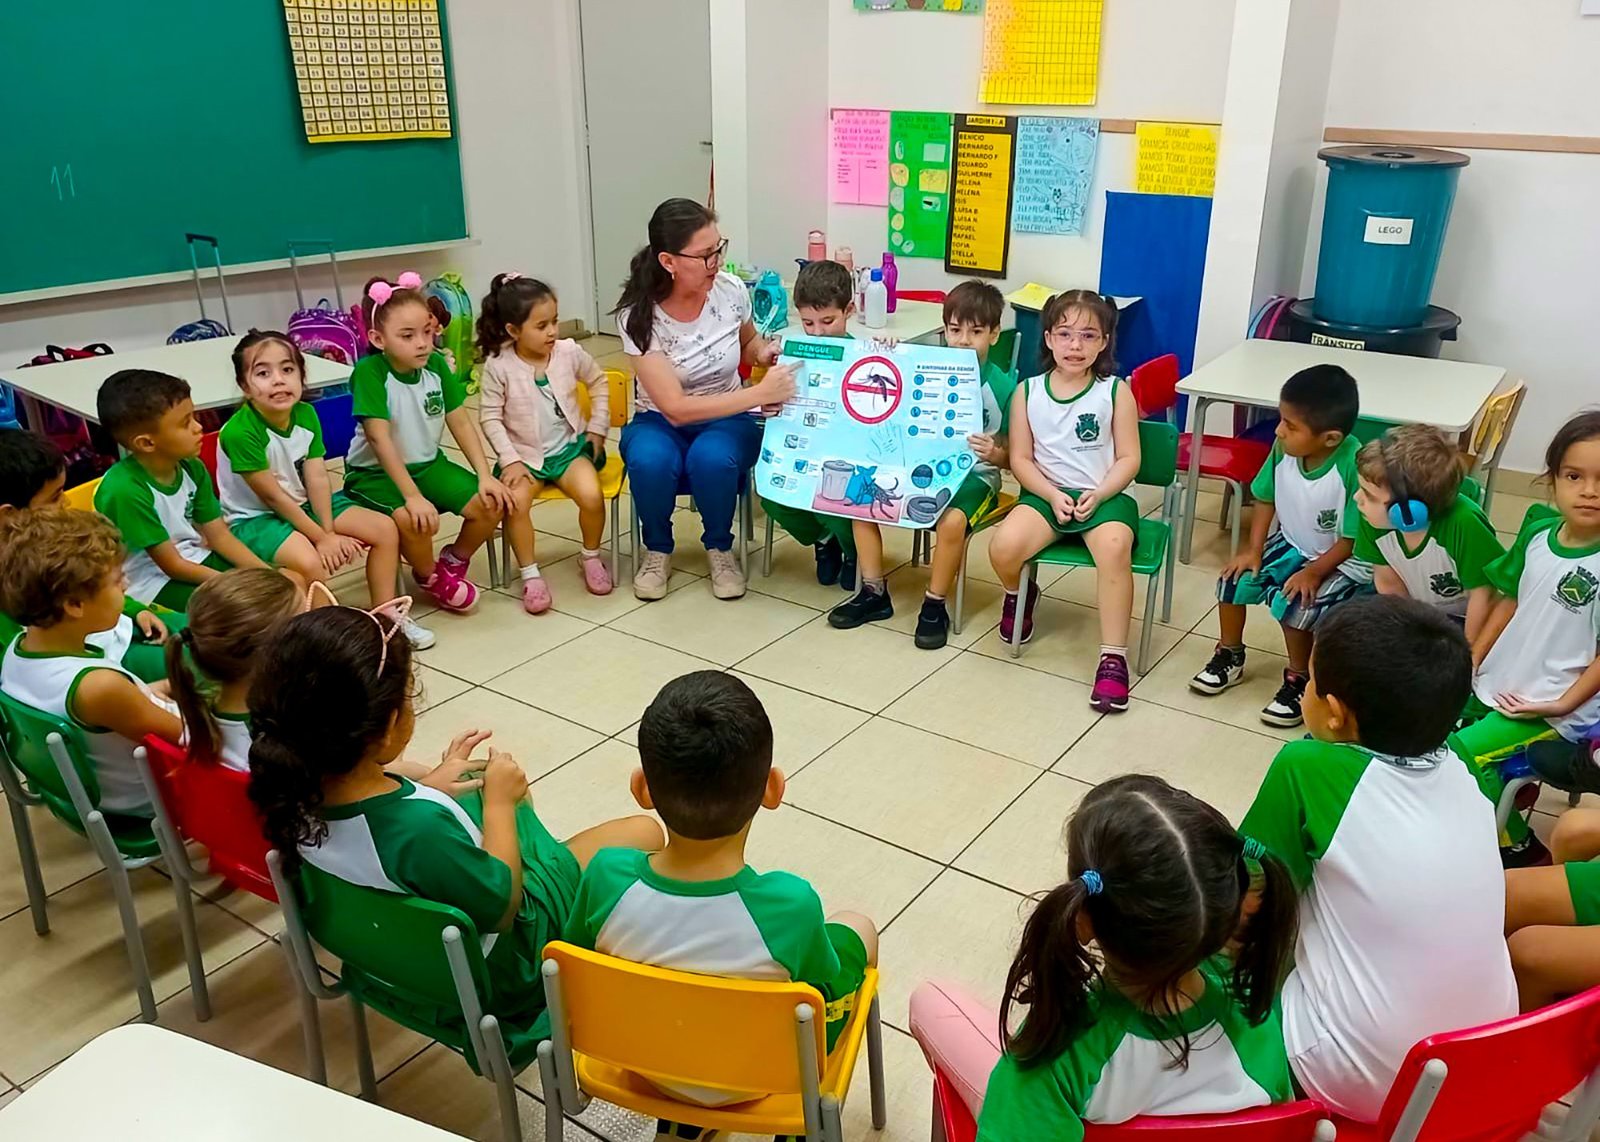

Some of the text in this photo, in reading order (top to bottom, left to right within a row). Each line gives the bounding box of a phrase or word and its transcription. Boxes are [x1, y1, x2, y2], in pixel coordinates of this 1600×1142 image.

[958, 170, 992, 178] GUILHERME
[51, 164, 75, 201] 11
[798, 344, 829, 354] DENGUE
